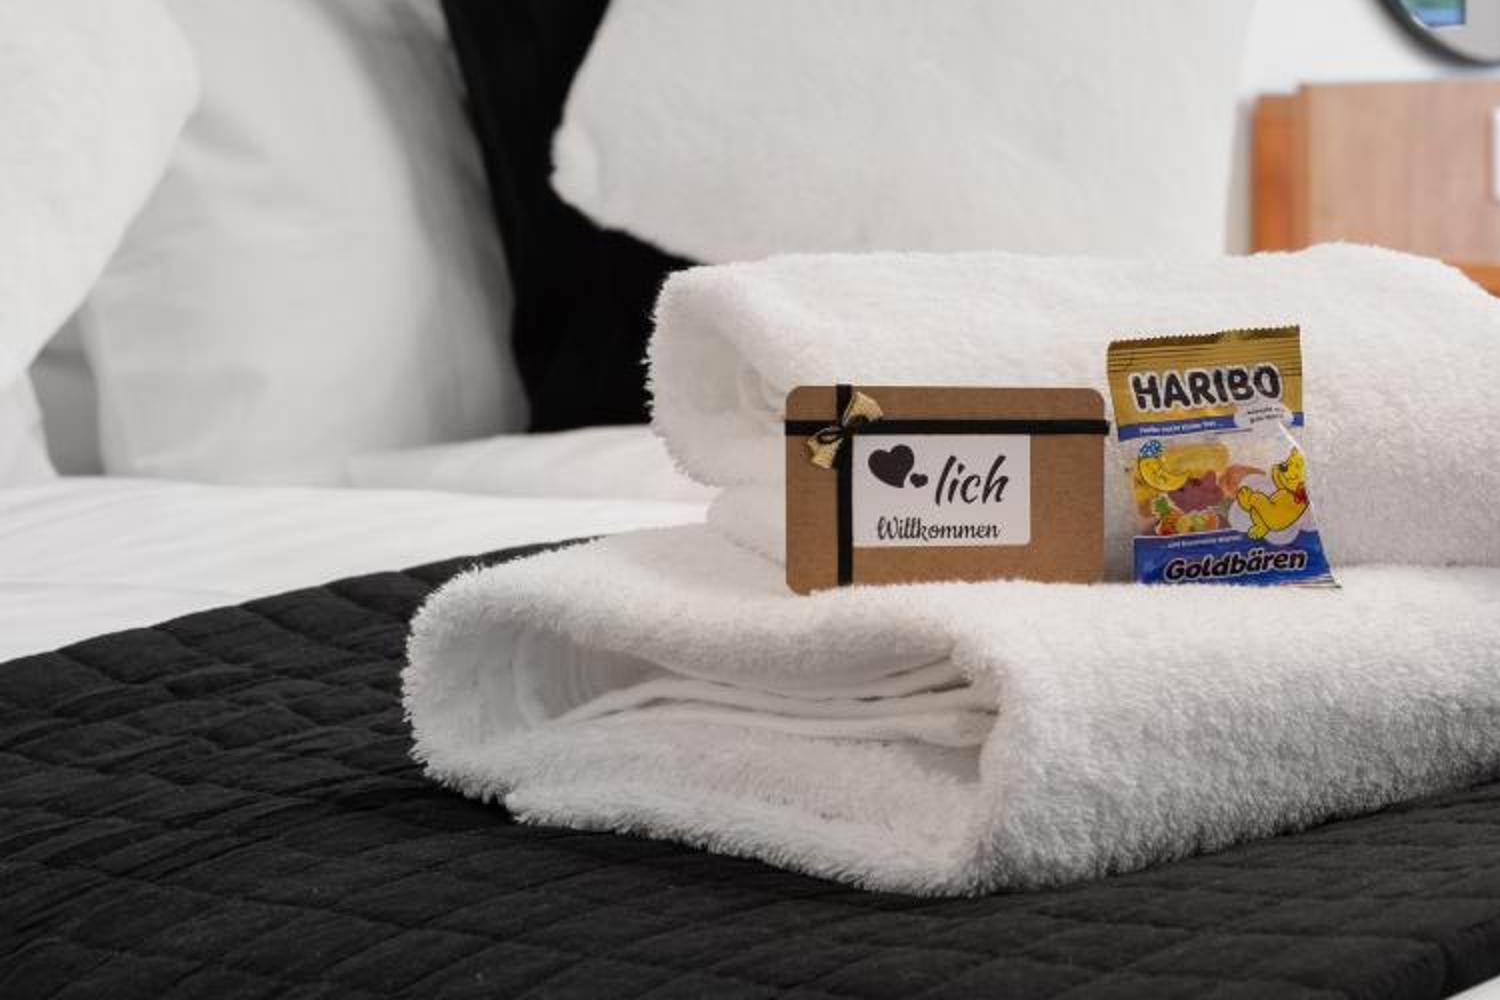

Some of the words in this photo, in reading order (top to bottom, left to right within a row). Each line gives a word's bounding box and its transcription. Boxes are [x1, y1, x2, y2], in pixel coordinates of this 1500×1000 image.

[1131, 364, 1281, 410] HARIBO
[935, 455, 1009, 506] lich
[877, 515, 1000, 541] Willkommen
[1164, 549, 1306, 581] Goldbären
